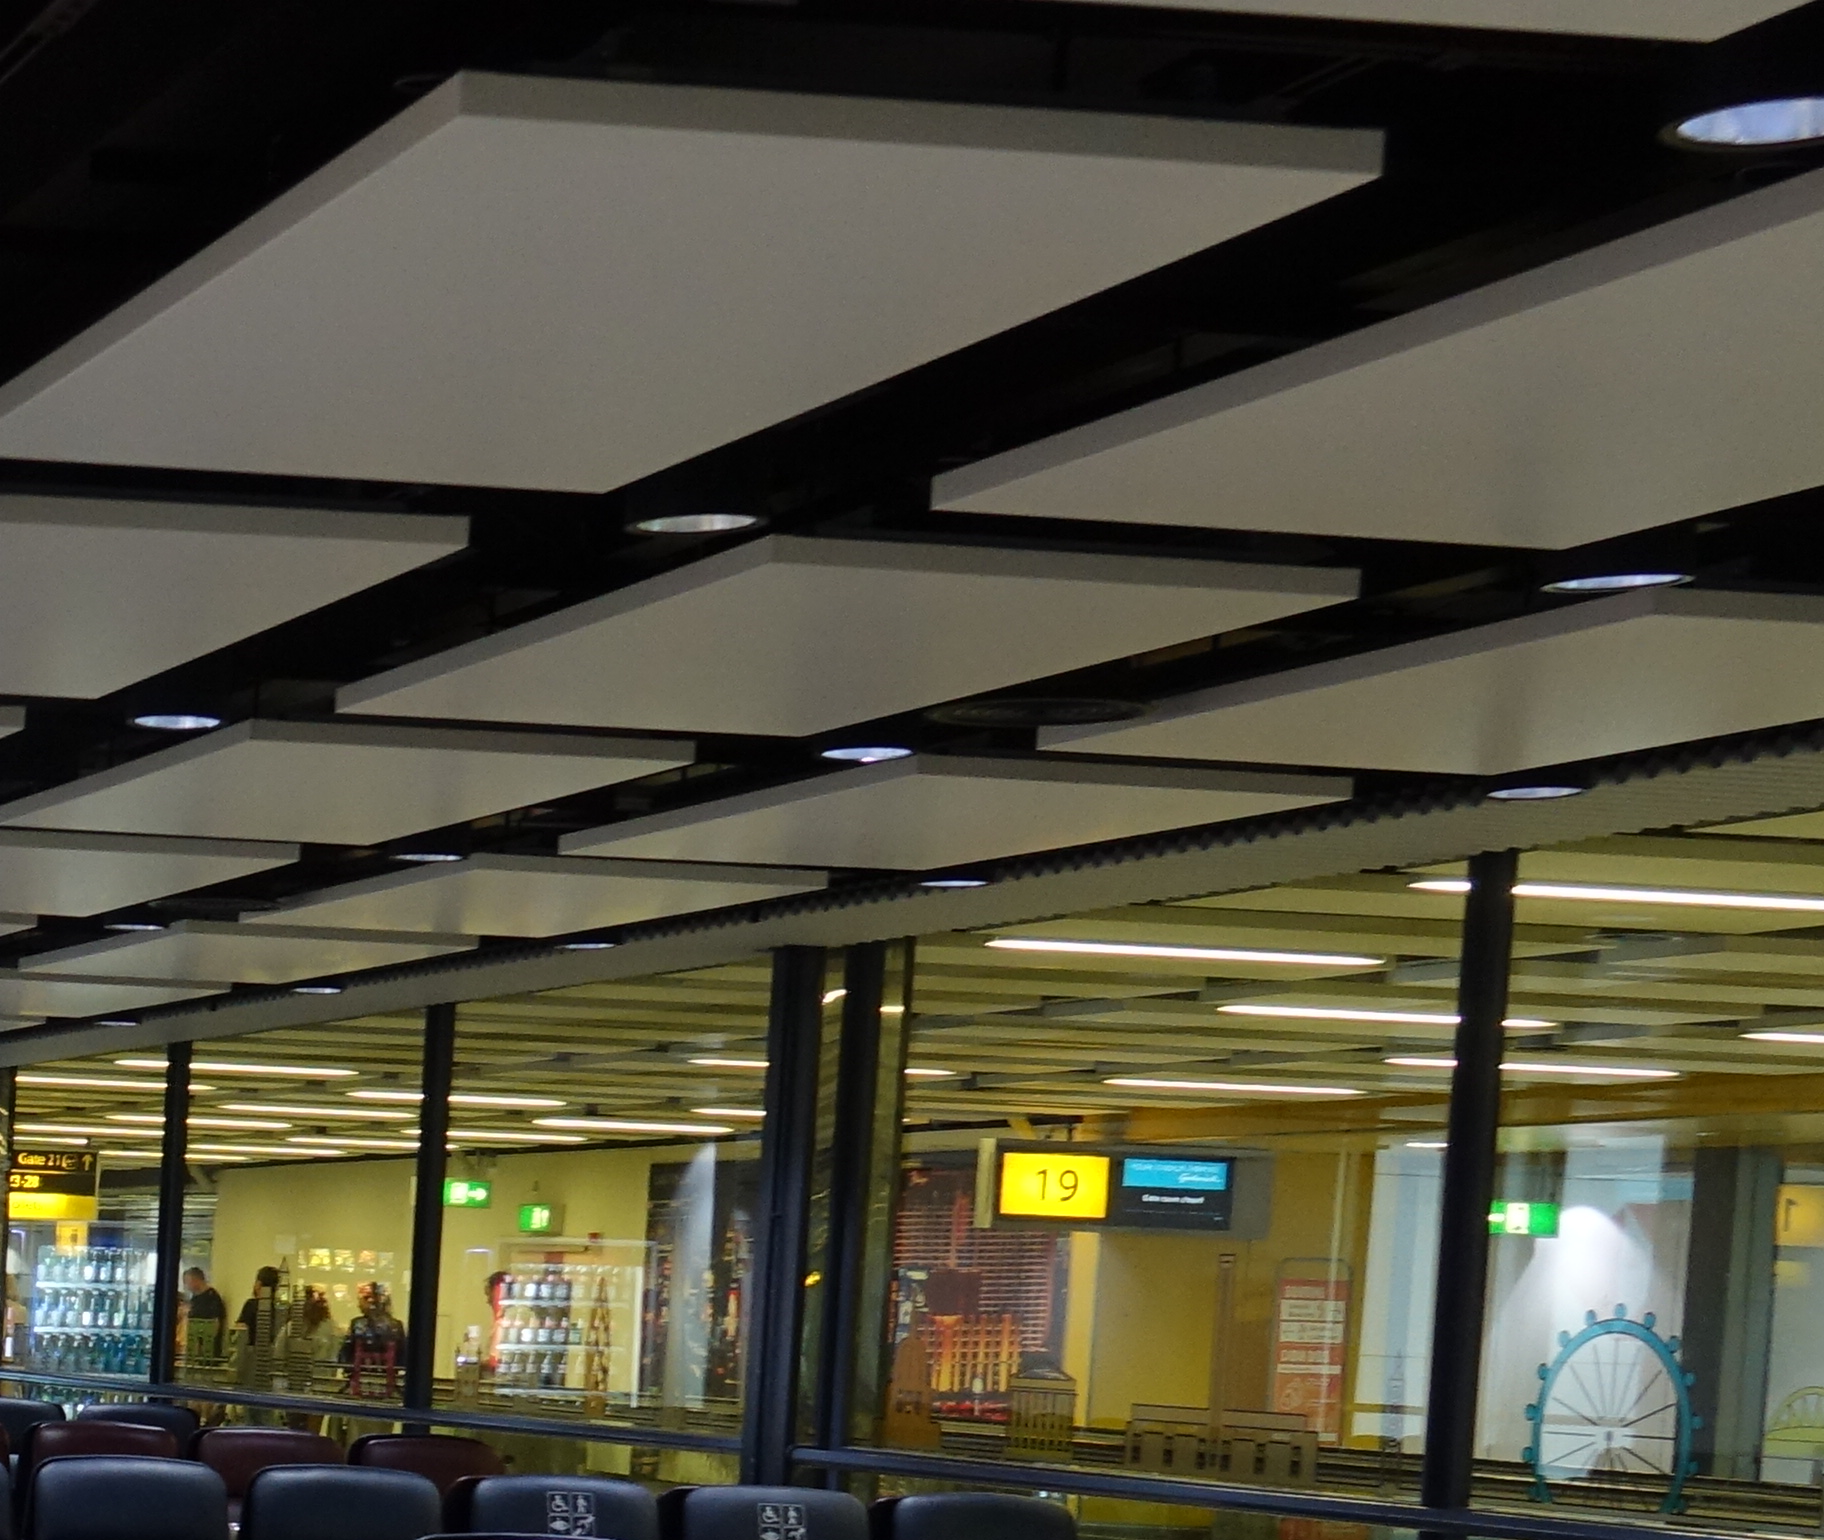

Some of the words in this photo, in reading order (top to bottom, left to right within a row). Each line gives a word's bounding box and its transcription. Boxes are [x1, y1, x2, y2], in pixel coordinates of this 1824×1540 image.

[18, 1152, 46, 1166] Gate
[9, 1174, 40, 1188] 3-28
[1036, 1168, 1078, 1202] 19
